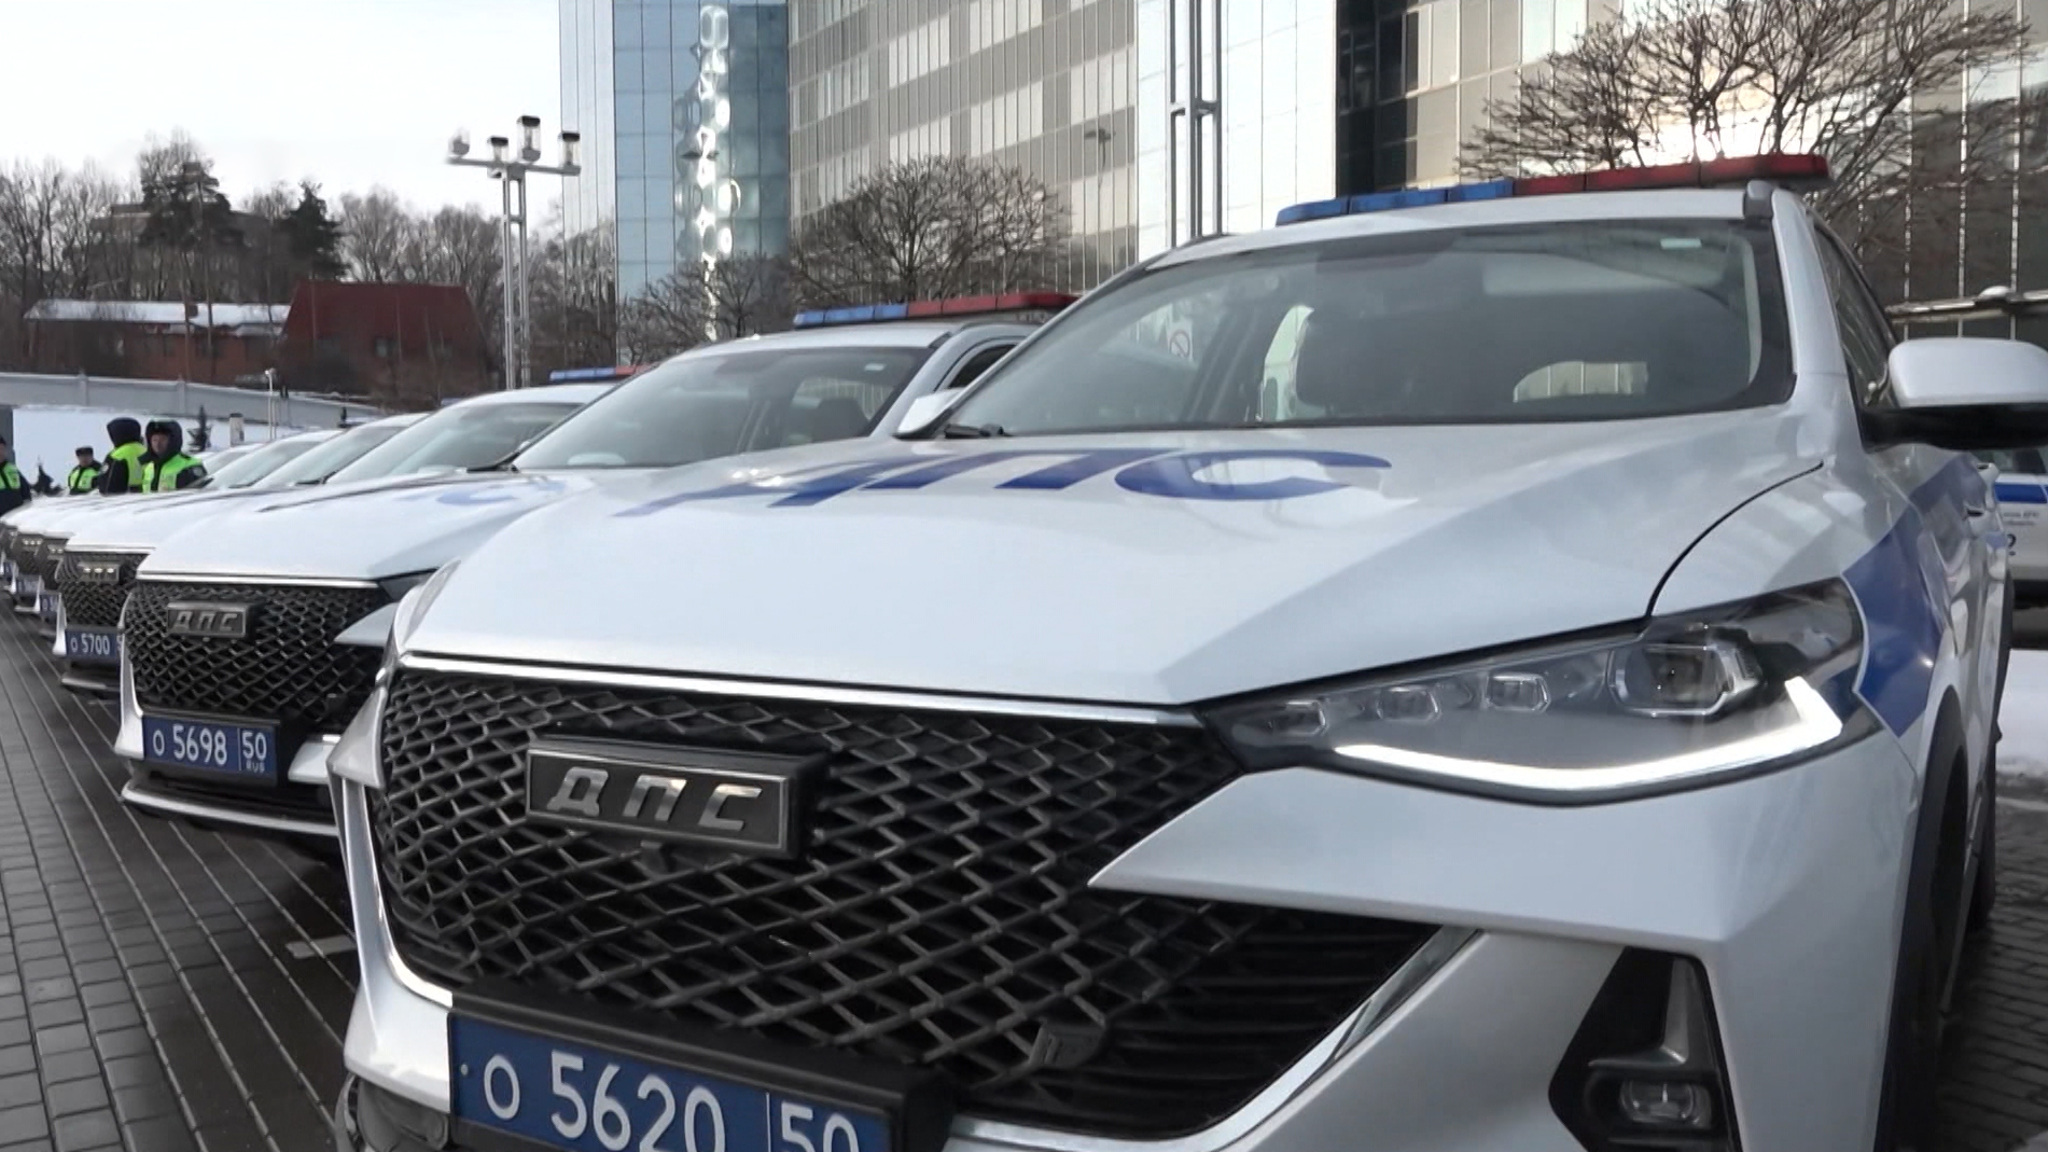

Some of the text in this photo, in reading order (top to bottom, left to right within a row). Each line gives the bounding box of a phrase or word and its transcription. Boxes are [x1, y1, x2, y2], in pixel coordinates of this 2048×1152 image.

[173, 611, 238, 632] ДПС
[81, 633, 110, 655] 5700
[172, 723, 227, 765] 5698
[242, 731, 267, 761] 50
[547, 766, 763, 832] ДПС
[551, 1050, 726, 1152] 5620
[781, 1101, 859, 1152] 50
